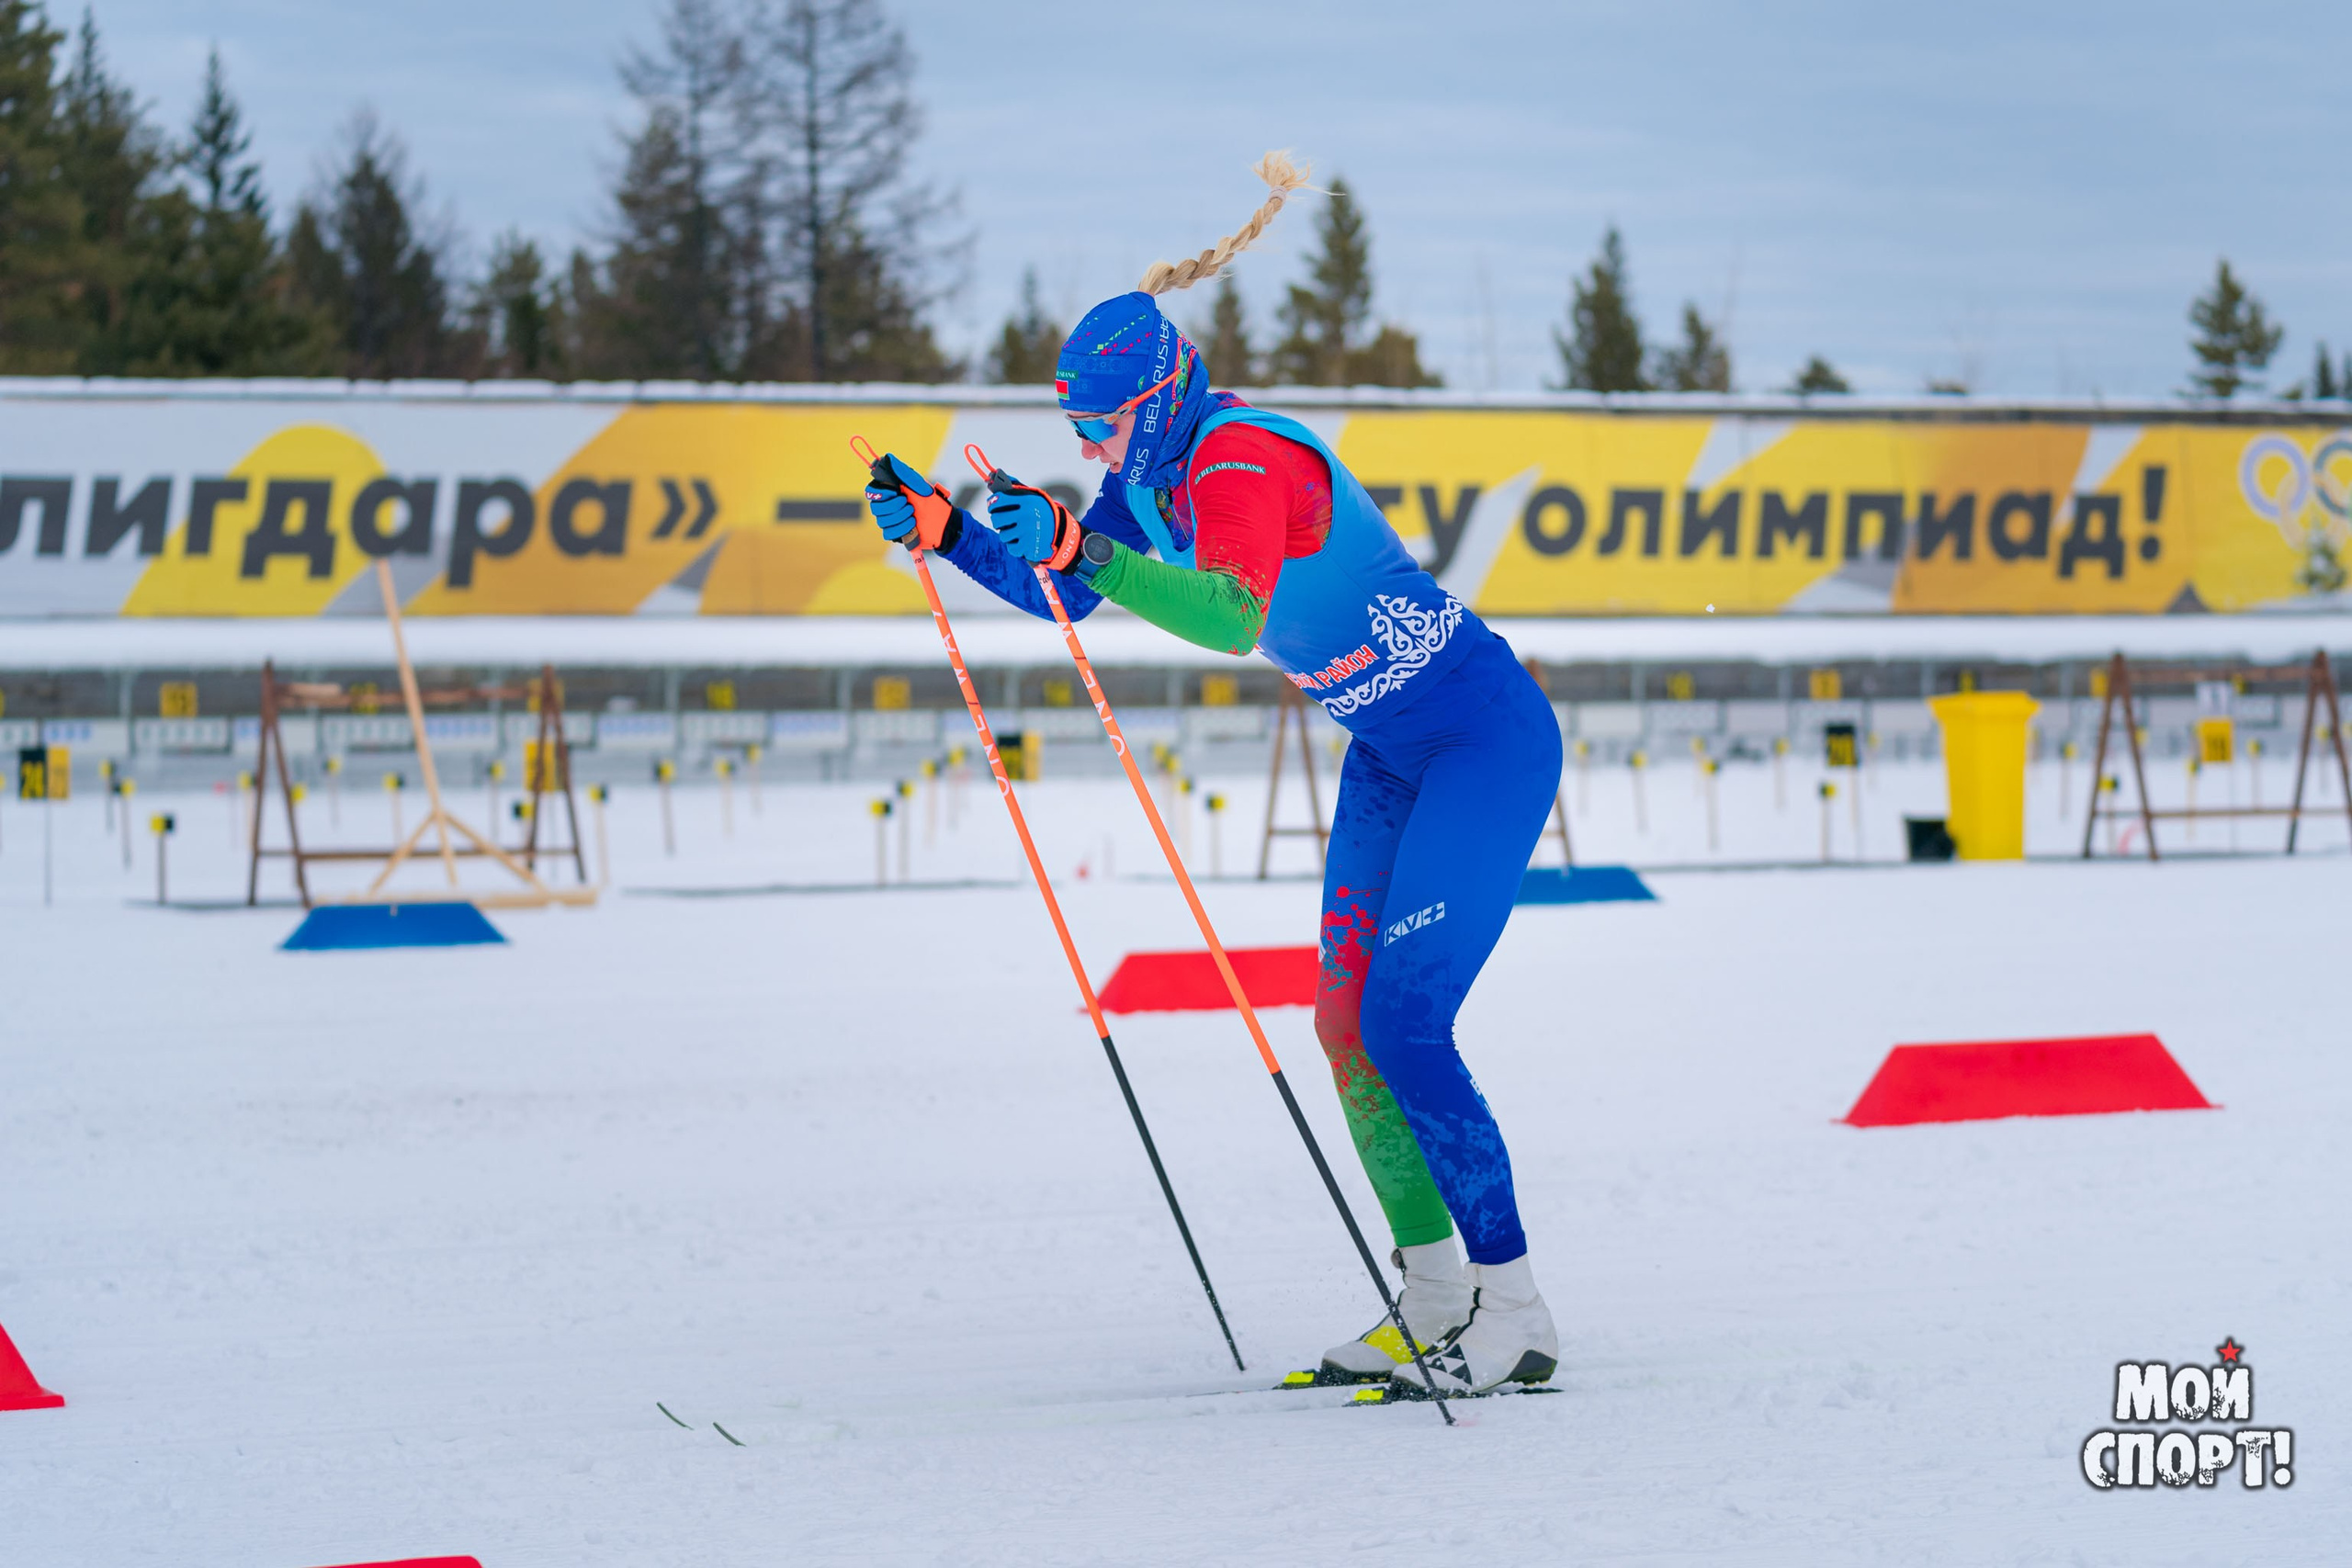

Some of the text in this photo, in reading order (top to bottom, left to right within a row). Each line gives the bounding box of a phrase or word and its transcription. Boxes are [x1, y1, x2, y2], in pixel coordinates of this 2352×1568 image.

[1200, 461, 1265, 477] BELARUSBANK
[1521, 465, 2168, 580] олимпиад!
[1314, 644, 1379, 688] РАЙОН
